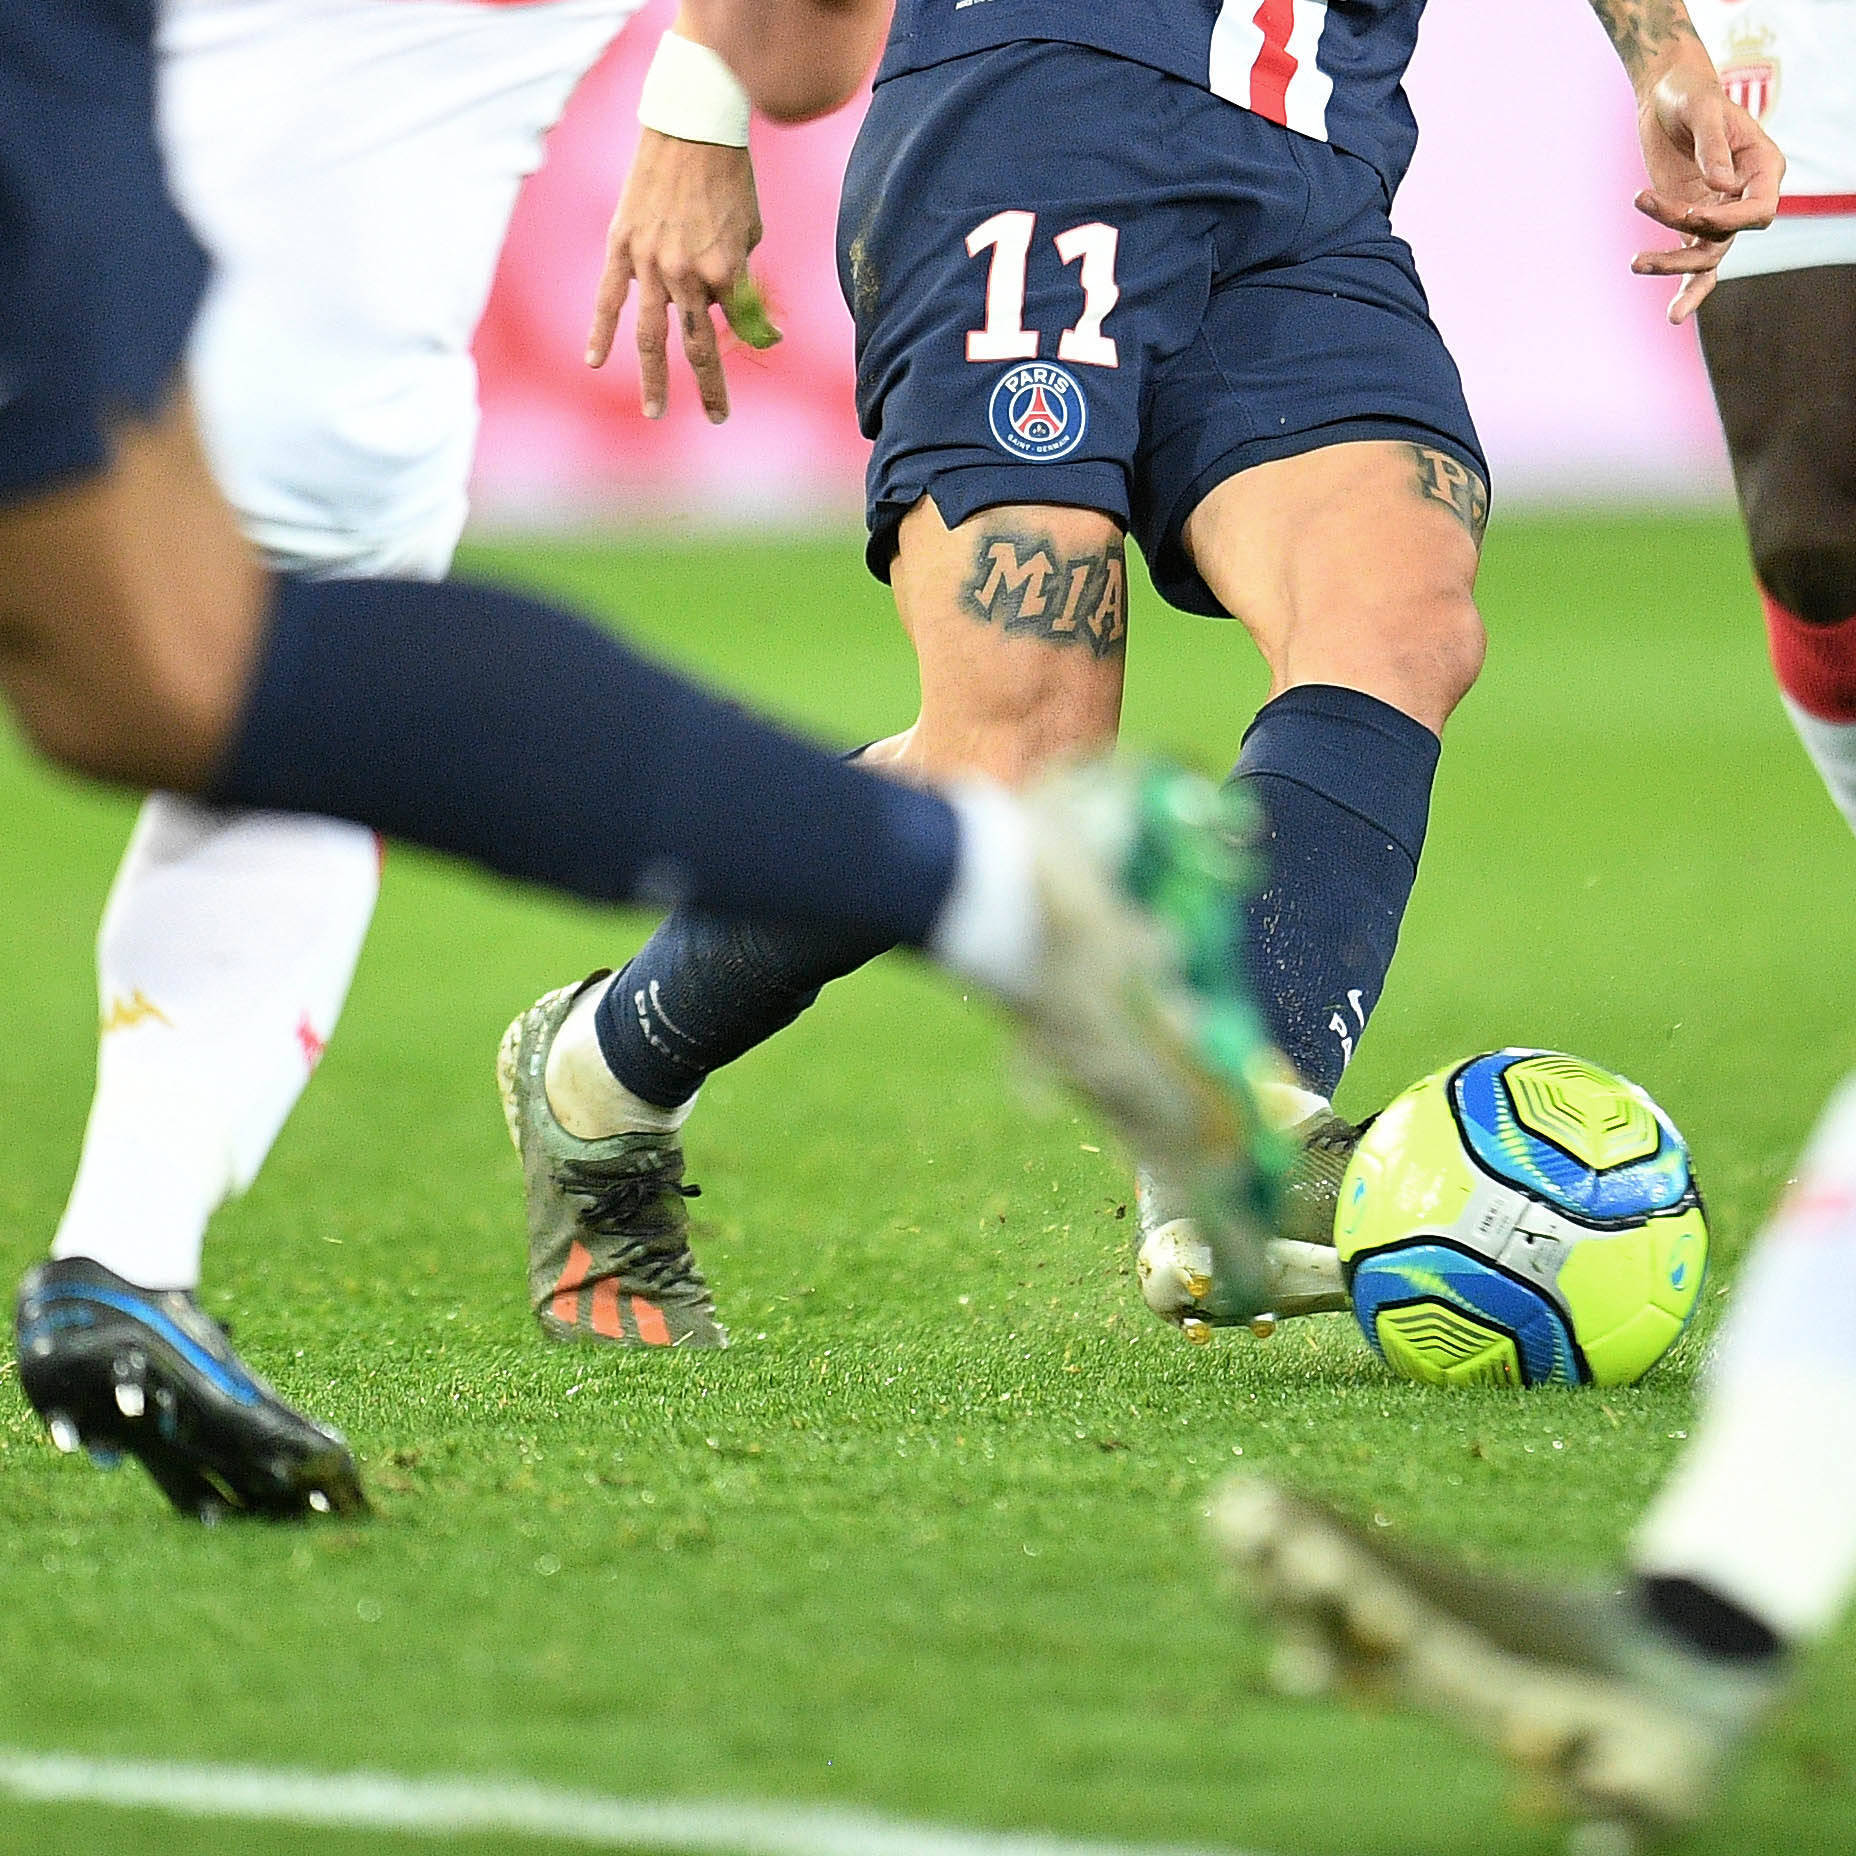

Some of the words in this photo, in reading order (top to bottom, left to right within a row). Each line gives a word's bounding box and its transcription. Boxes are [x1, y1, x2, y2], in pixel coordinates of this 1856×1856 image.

[964, 208, 1120, 369] 11
[1004, 368, 1070, 394] PARIS
[974, 542, 1124, 641] MIA
